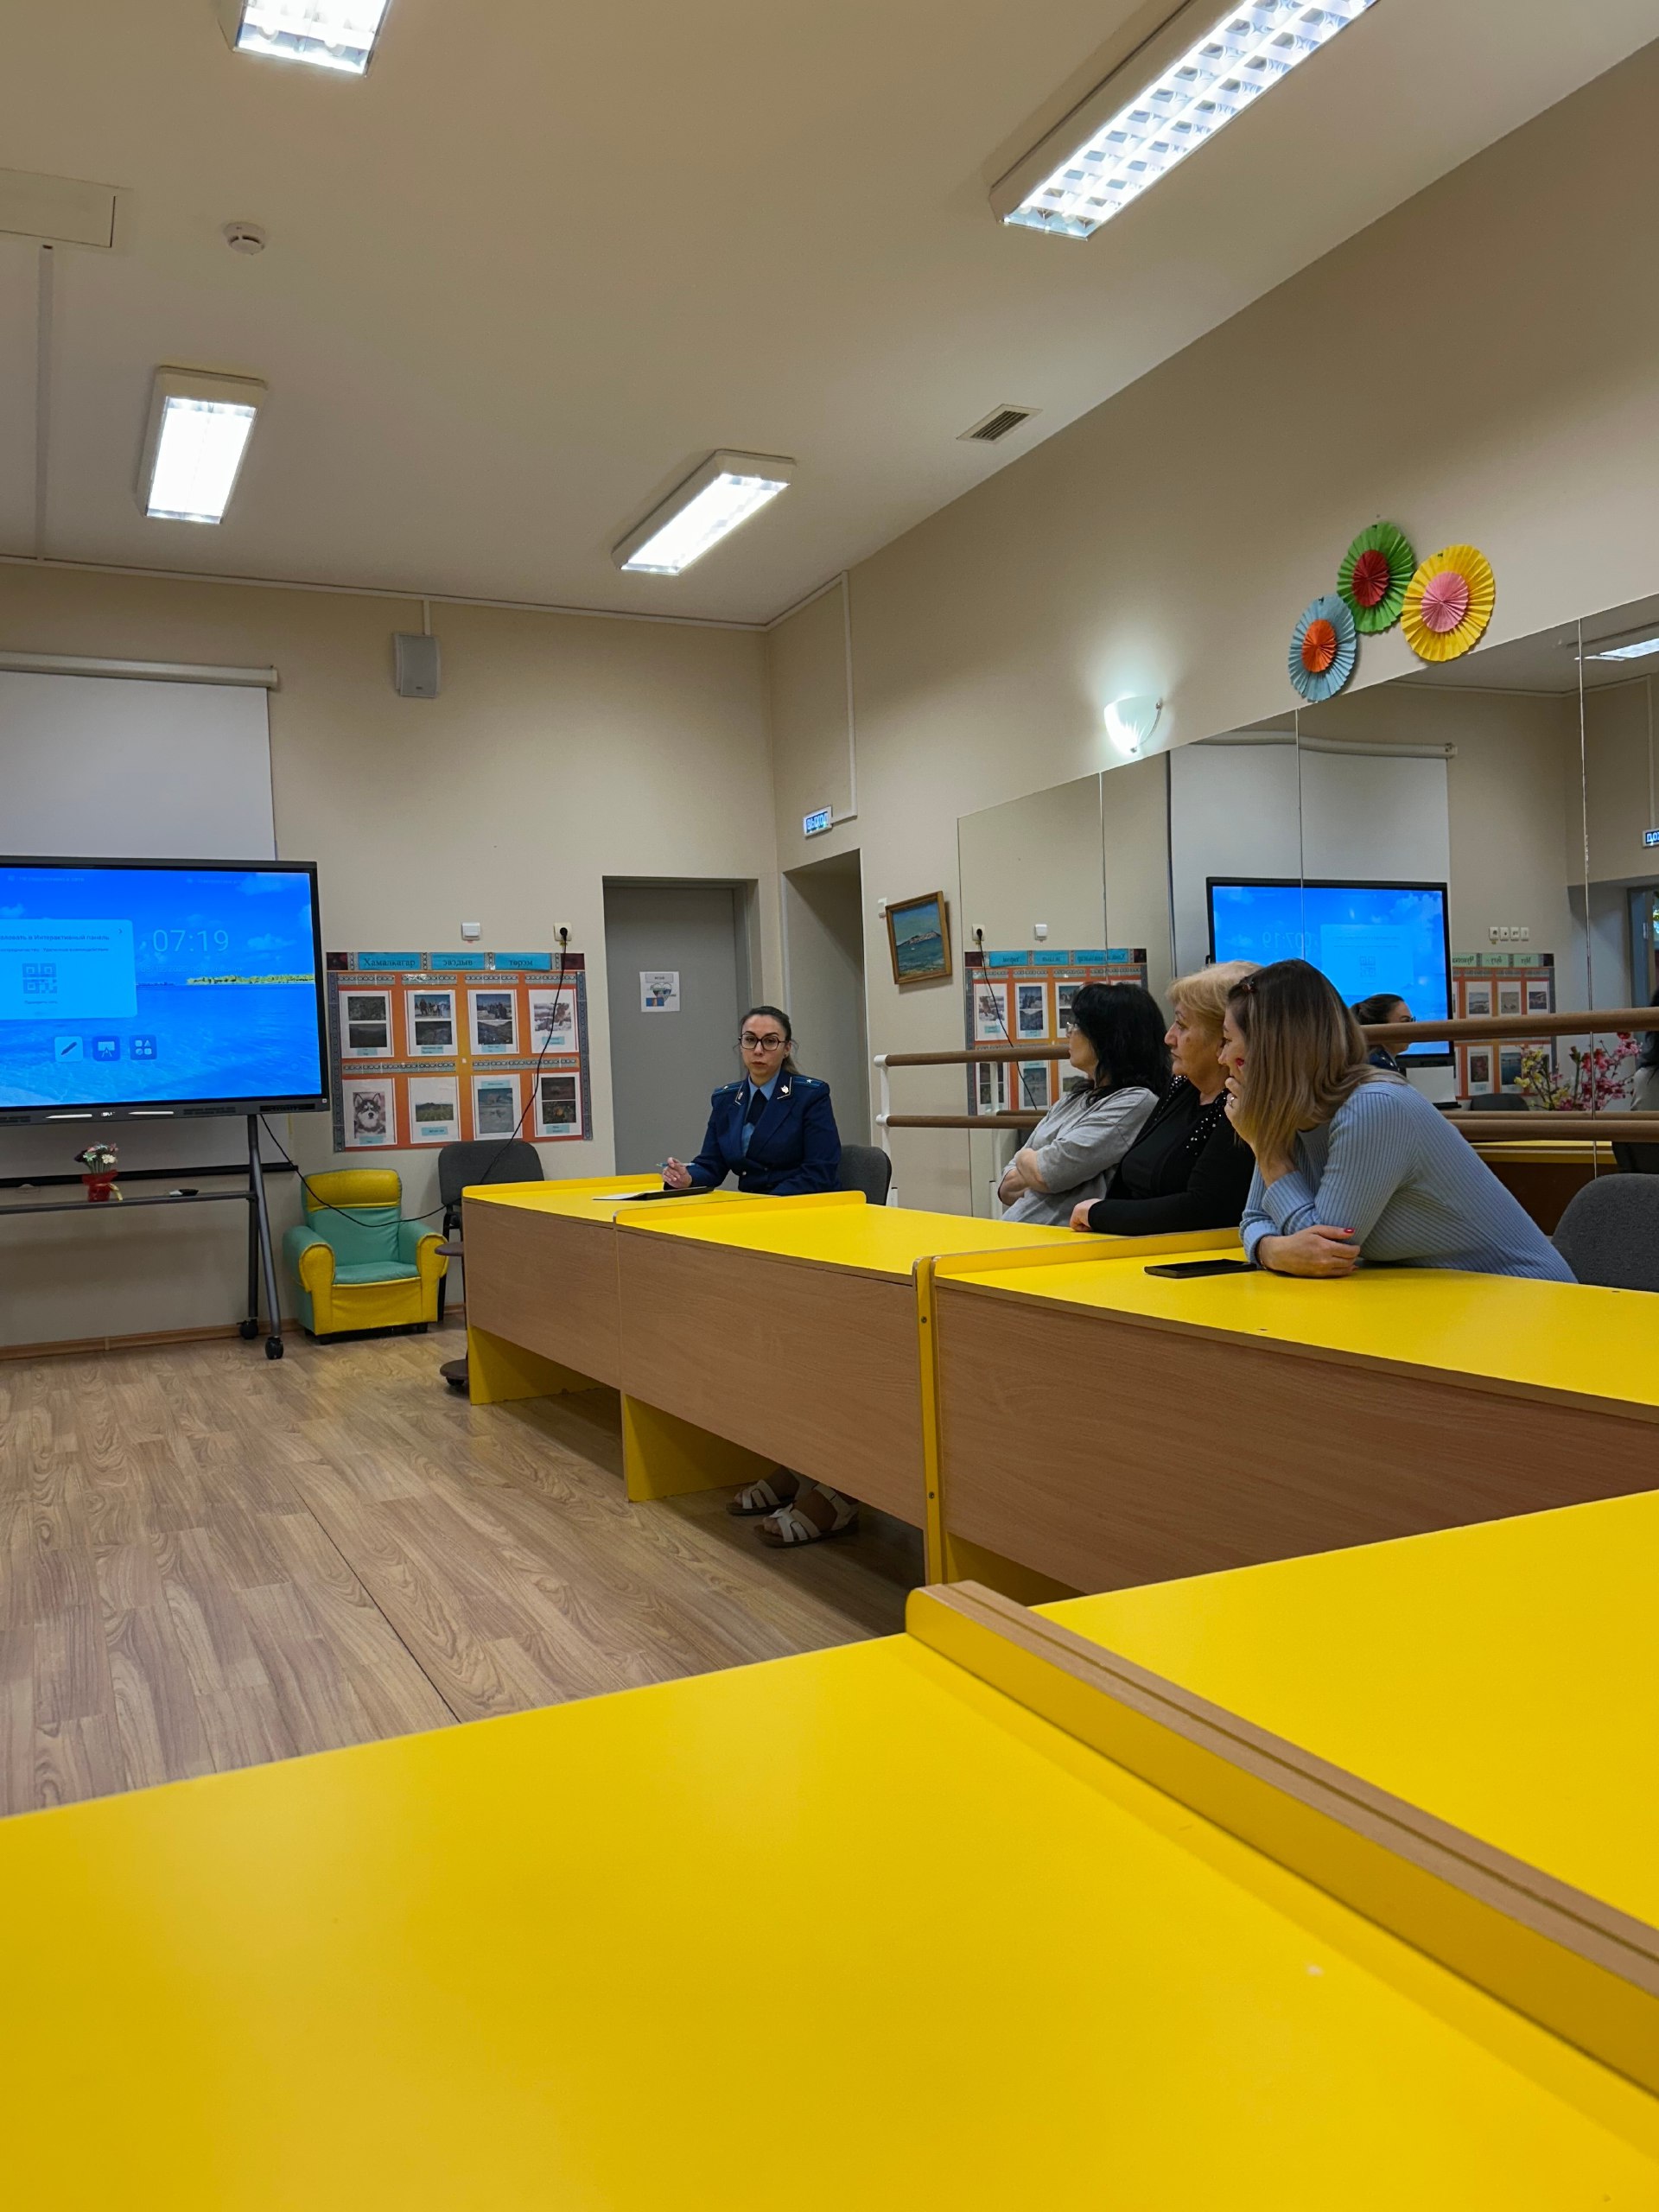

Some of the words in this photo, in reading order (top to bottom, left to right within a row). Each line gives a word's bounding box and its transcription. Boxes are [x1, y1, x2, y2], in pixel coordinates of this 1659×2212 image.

[807, 813, 830, 830] ВЫХОД
[153, 930, 228, 951] 07:19
[364, 958, 415, 968] Хамалкагар
